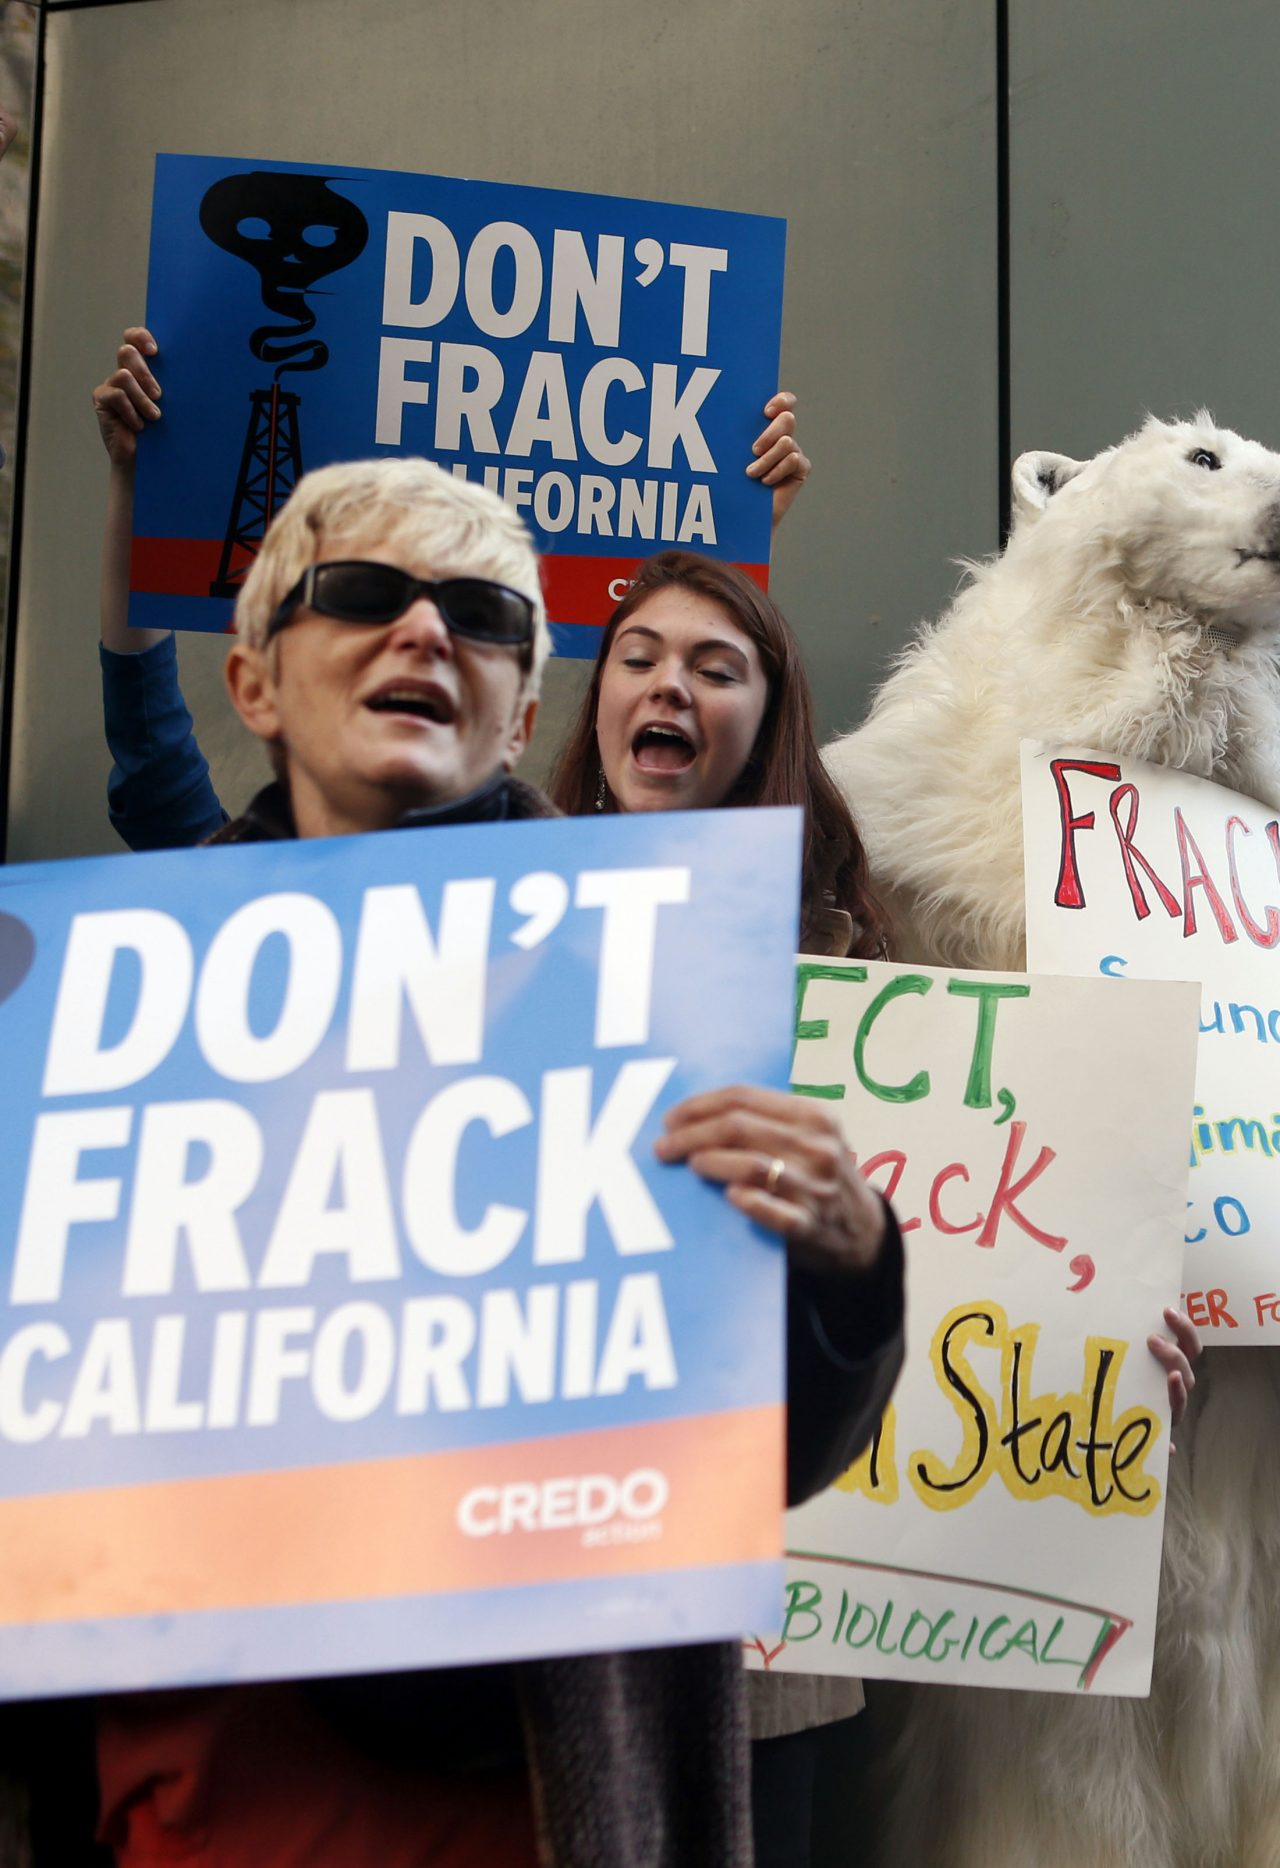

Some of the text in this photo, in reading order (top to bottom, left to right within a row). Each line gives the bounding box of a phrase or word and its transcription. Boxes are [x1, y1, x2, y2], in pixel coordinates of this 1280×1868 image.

[382, 211, 728, 356] DON'T
[375, 337, 721, 473] FRACK
[384, 457, 717, 545] FORNIA
[41, 867, 692, 1097] DON'T
[10, 1057, 679, 1306] FRACK
[0, 1272, 678, 1444] CALIFORNIA
[917, 1312, 1151, 1506] State
[456, 1468, 669, 1537] CREDO
[781, 1580, 1089, 1665] BIOLOGICAL
